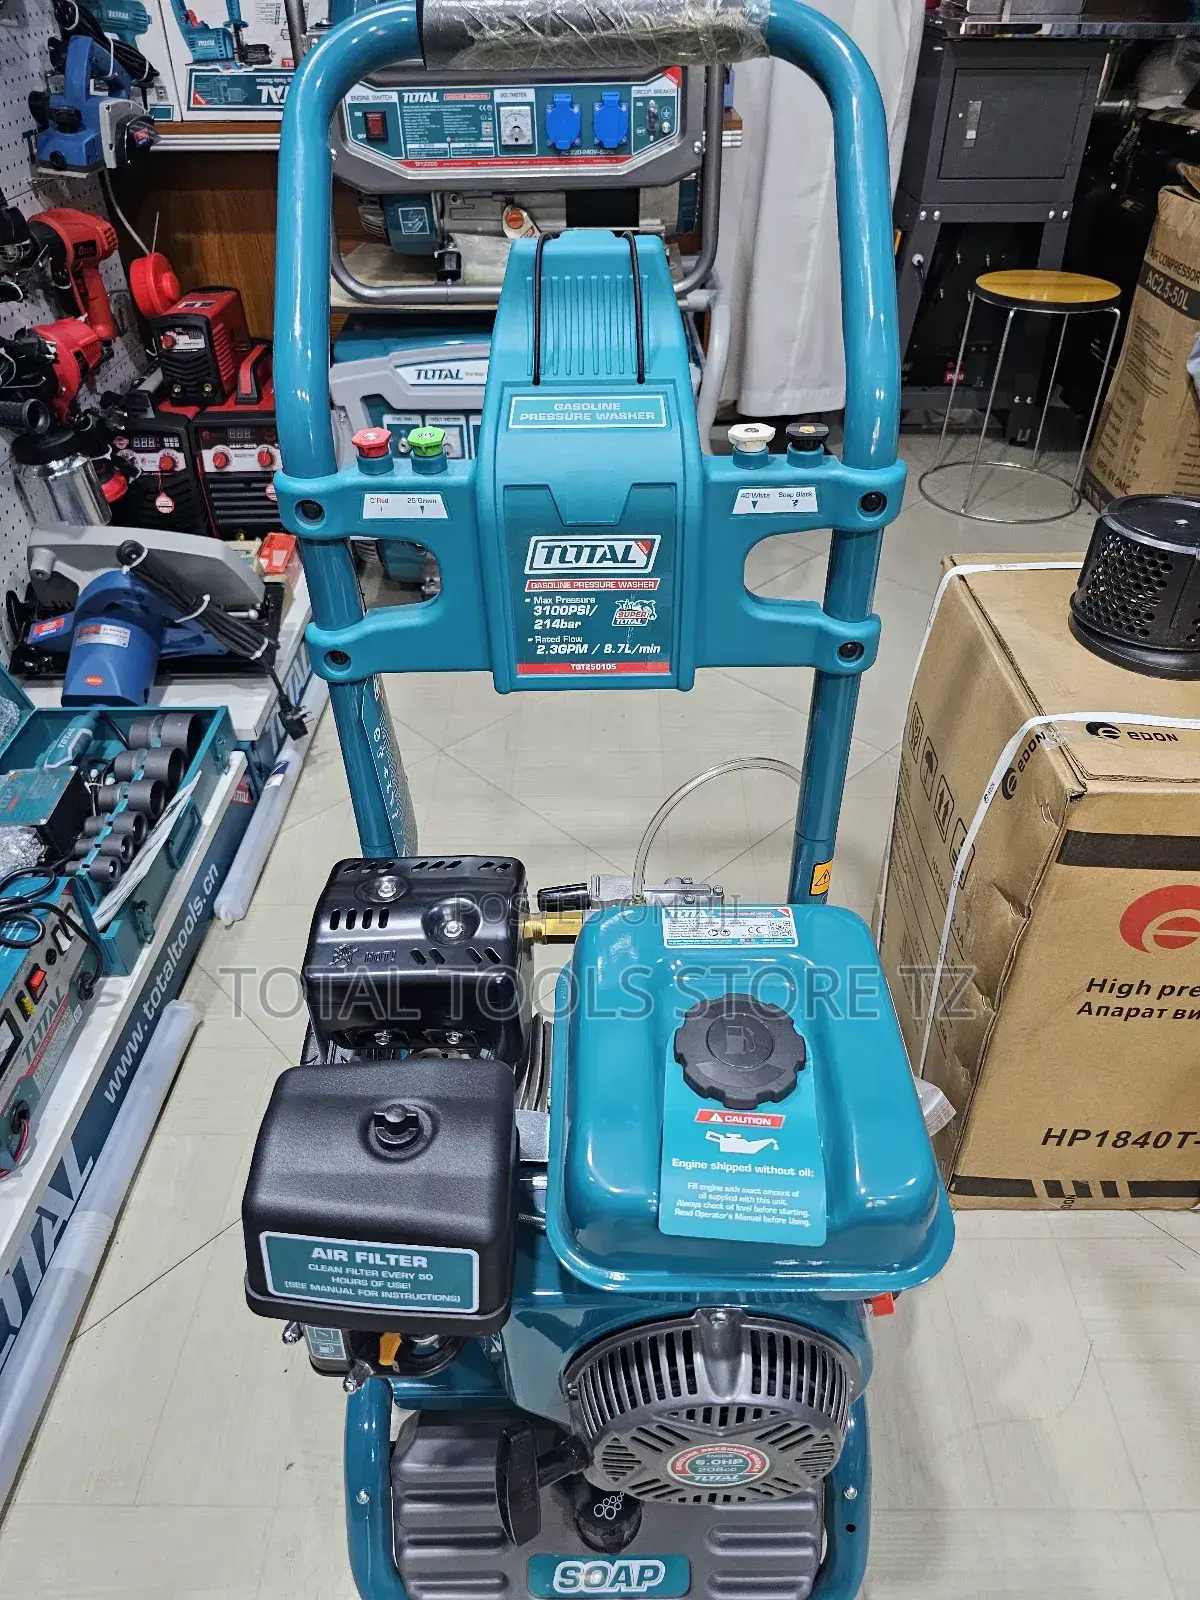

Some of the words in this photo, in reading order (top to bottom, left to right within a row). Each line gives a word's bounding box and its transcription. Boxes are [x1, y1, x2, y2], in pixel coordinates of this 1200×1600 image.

[402, 92, 440, 104] TOTAL
[415, 368, 464, 380] TOTAL
[554, 402, 621, 411] GASOLINE
[520, 412, 592, 421] PRESSURE
[596, 412, 656, 420] WASHER
[540, 544, 637, 565] TOTAL
[533, 605, 599, 616] 3100PSI/
[533, 618, 582, 630] 214bar
[536, 644, 588, 654] 2.3GPM
[603, 644, 661, 654] 8.7L/min
[57, 728, 76, 748] TOTAL
[668, 910, 716, 918] TOTAL
[364, 950, 396, 962] HOT!
[104, 862, 219, 1104] www.totaltools.cn
[1086, 978, 1152, 998] High
[1156, 984, 1200, 1000] pre
[1076, 1001, 1168, 1021] Апарат
[22, 985, 65, 1066] TOTAL
[724, 1115, 772, 1126] CAUTION
[672, 1158, 708, 1170] Engine
[711, 1162, 751, 1173] shipped
[755, 1164, 796, 1176] without
[798, 1166, 814, 1177] oil:
[700, 1184, 723, 1193] engine
[763, 1188, 791, 1196] amount
[708, 1193, 738, 1204] supplied
[676, 1199, 701, 1210] Always
[703, 1201, 724, 1210] check
[754, 1206, 777, 1214] before
[779, 1208, 810, 1218] starting.
[674, 1209, 694, 1217] Read
[695, 1210, 733, 1220] Operator's
[735, 1213, 762, 1222] Manual
[763, 1216, 787, 1224] before
[788, 1217, 811, 1228] Using.
[311, 1248, 348, 1262] AIR
[355, 1251, 428, 1268] FILTER
[308, 1263, 343, 1274] CLEAN
[345, 1267, 379, 1278] FILTER
[382, 1271, 415, 1280] EVERY
[332, 1276, 368, 1286] HOURS
[370, 1279, 385, 1287] OF
[285, 1280, 307, 1290] (SEE
[309, 1284, 355, 1295] MANUAL
[358, 1289, 378, 1298] FOR
[381, 1291, 460, 1303] INSTRUCTIONS)
[554, 1560, 665, 1593] SOAP
